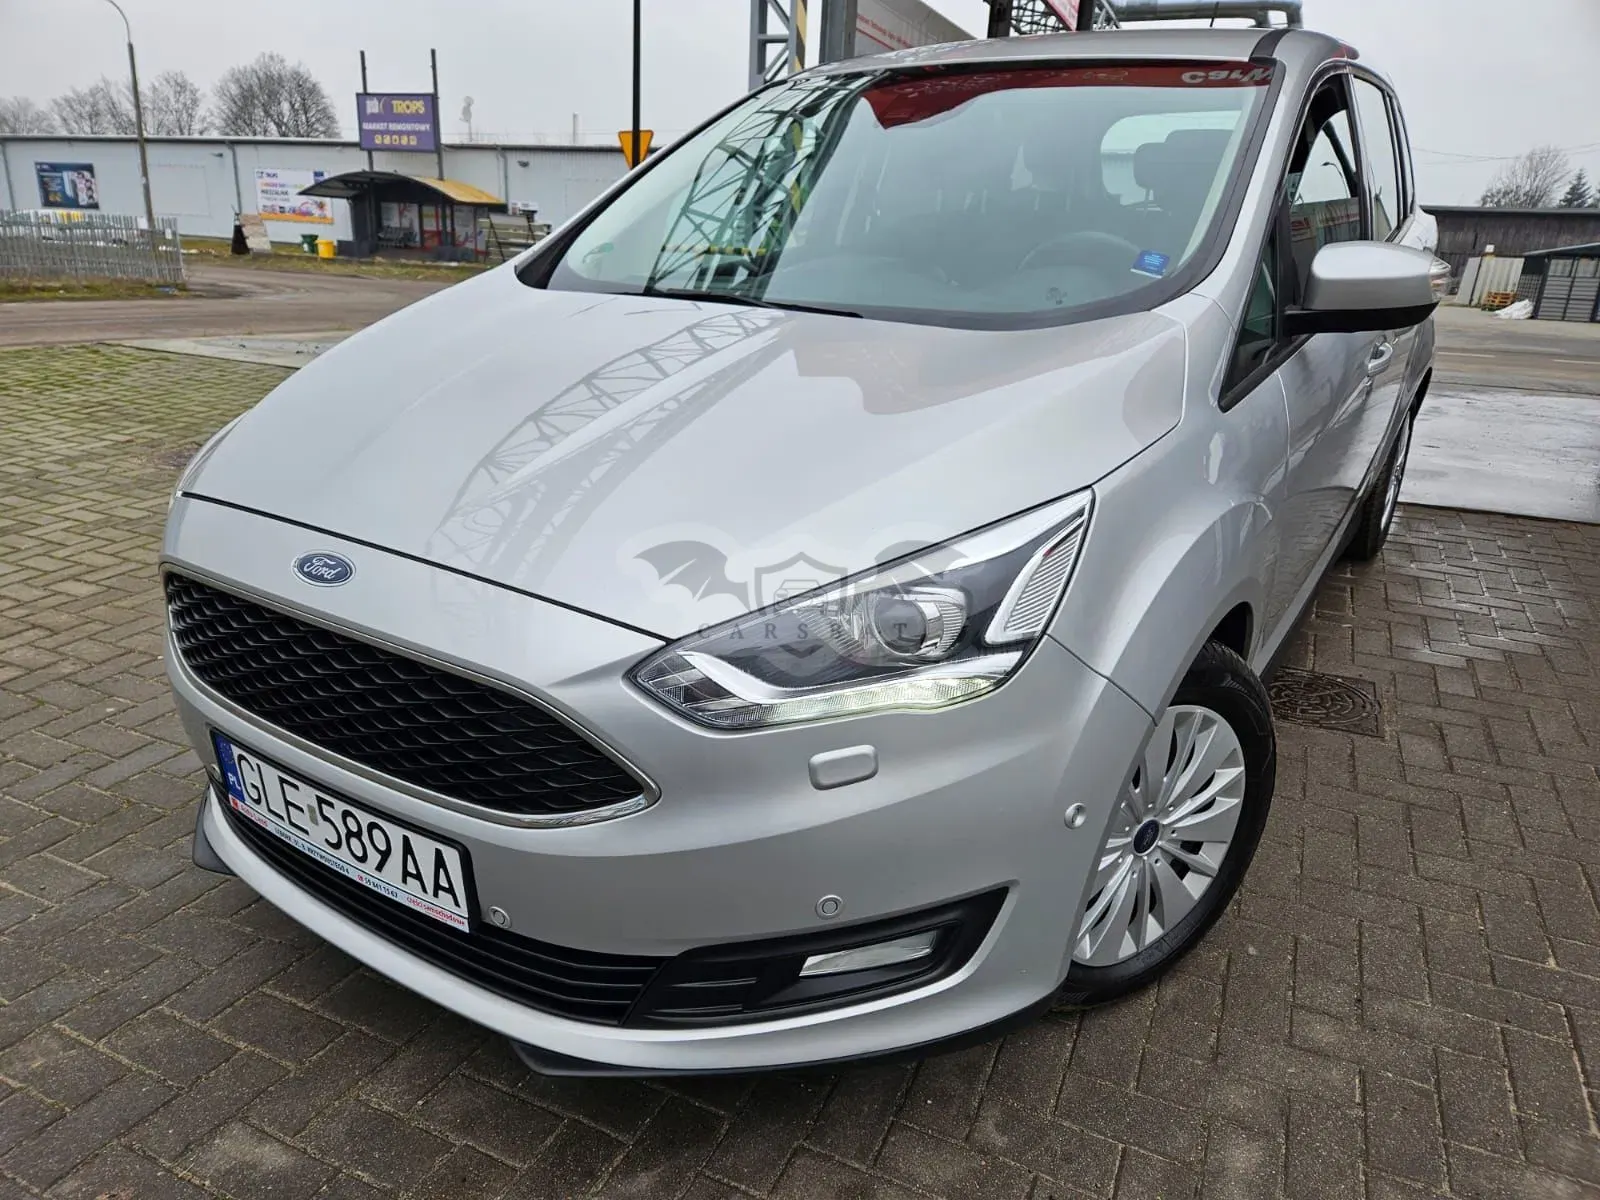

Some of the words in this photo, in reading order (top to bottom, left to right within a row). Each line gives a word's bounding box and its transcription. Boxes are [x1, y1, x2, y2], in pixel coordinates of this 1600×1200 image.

[391, 99, 425, 114] TROPS
[362, 122, 388, 131] MARKET
[303, 556, 342, 579] Ford
[228, 772, 241, 790] PL
[237, 753, 310, 837] GLE
[315, 794, 461, 909] 589AA
